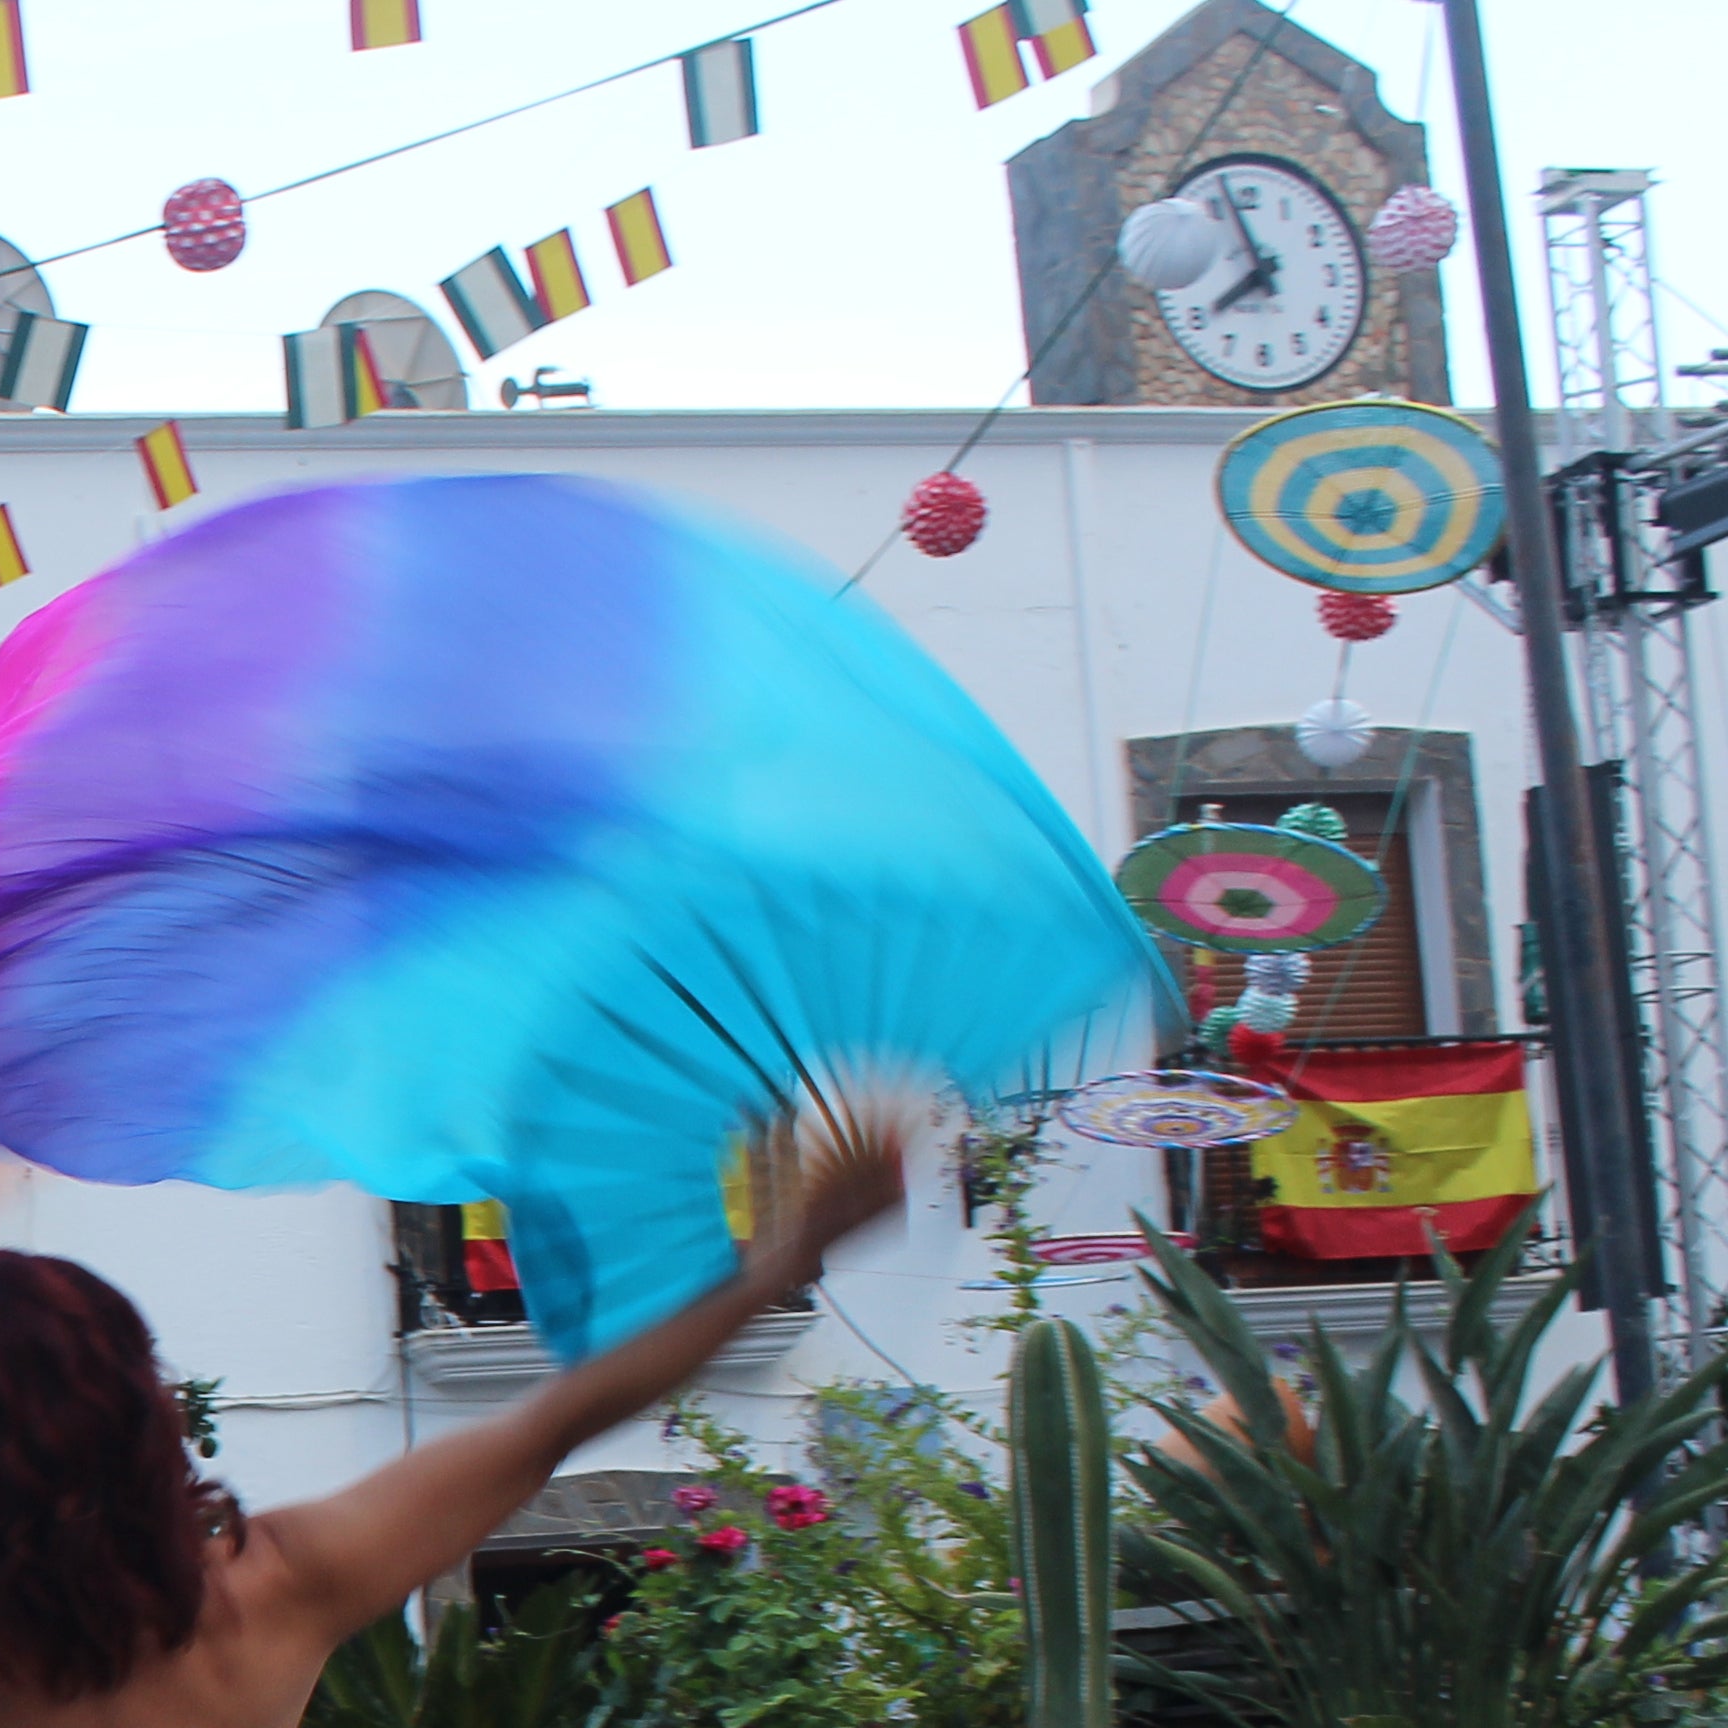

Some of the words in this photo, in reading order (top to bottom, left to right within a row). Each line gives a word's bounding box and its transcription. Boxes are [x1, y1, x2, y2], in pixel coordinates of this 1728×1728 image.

[1307, 223, 1323, 249] 2
[1323, 263, 1340, 288] 3
[1187, 305, 1207, 331] 8
[1315, 304, 1330, 329] 4
[1222, 333, 1238, 357] 7
[1255, 343, 1273, 368] 6
[1291, 332, 1308, 356] 5
